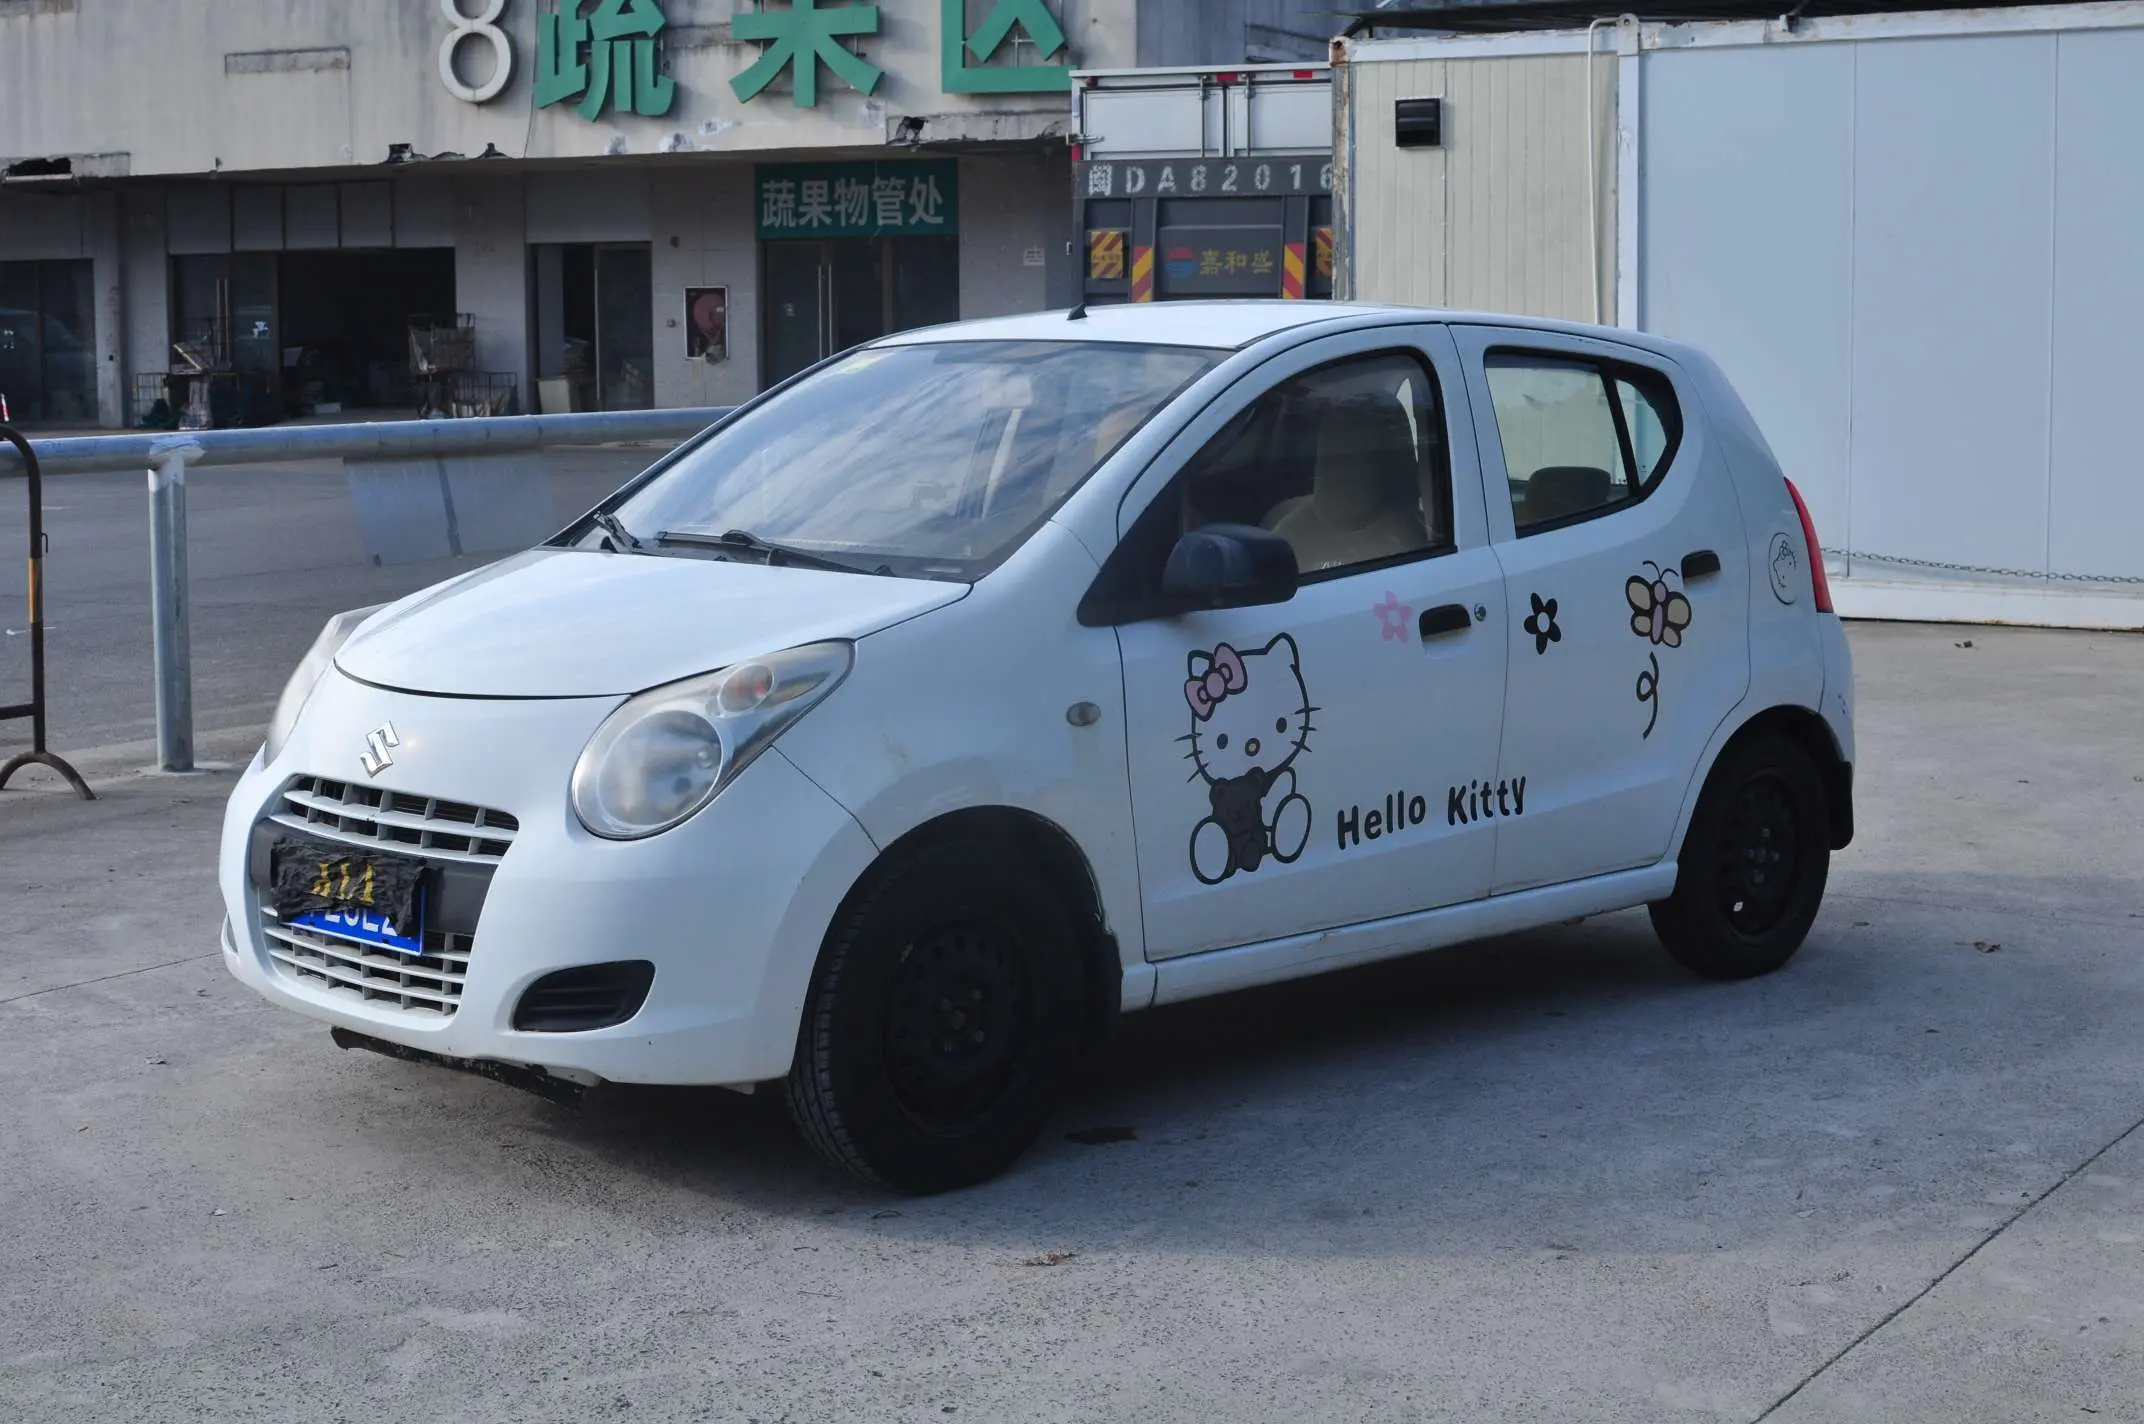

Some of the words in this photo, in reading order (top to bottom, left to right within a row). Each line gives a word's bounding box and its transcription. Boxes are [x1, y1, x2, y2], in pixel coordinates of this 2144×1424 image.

[761, 176, 945, 229] 蔬果物管处
[1200, 248, 1273, 276] 嘉和盛
[1337, 789, 1426, 850] Hello
[1447, 775, 1527, 826] Kitty
